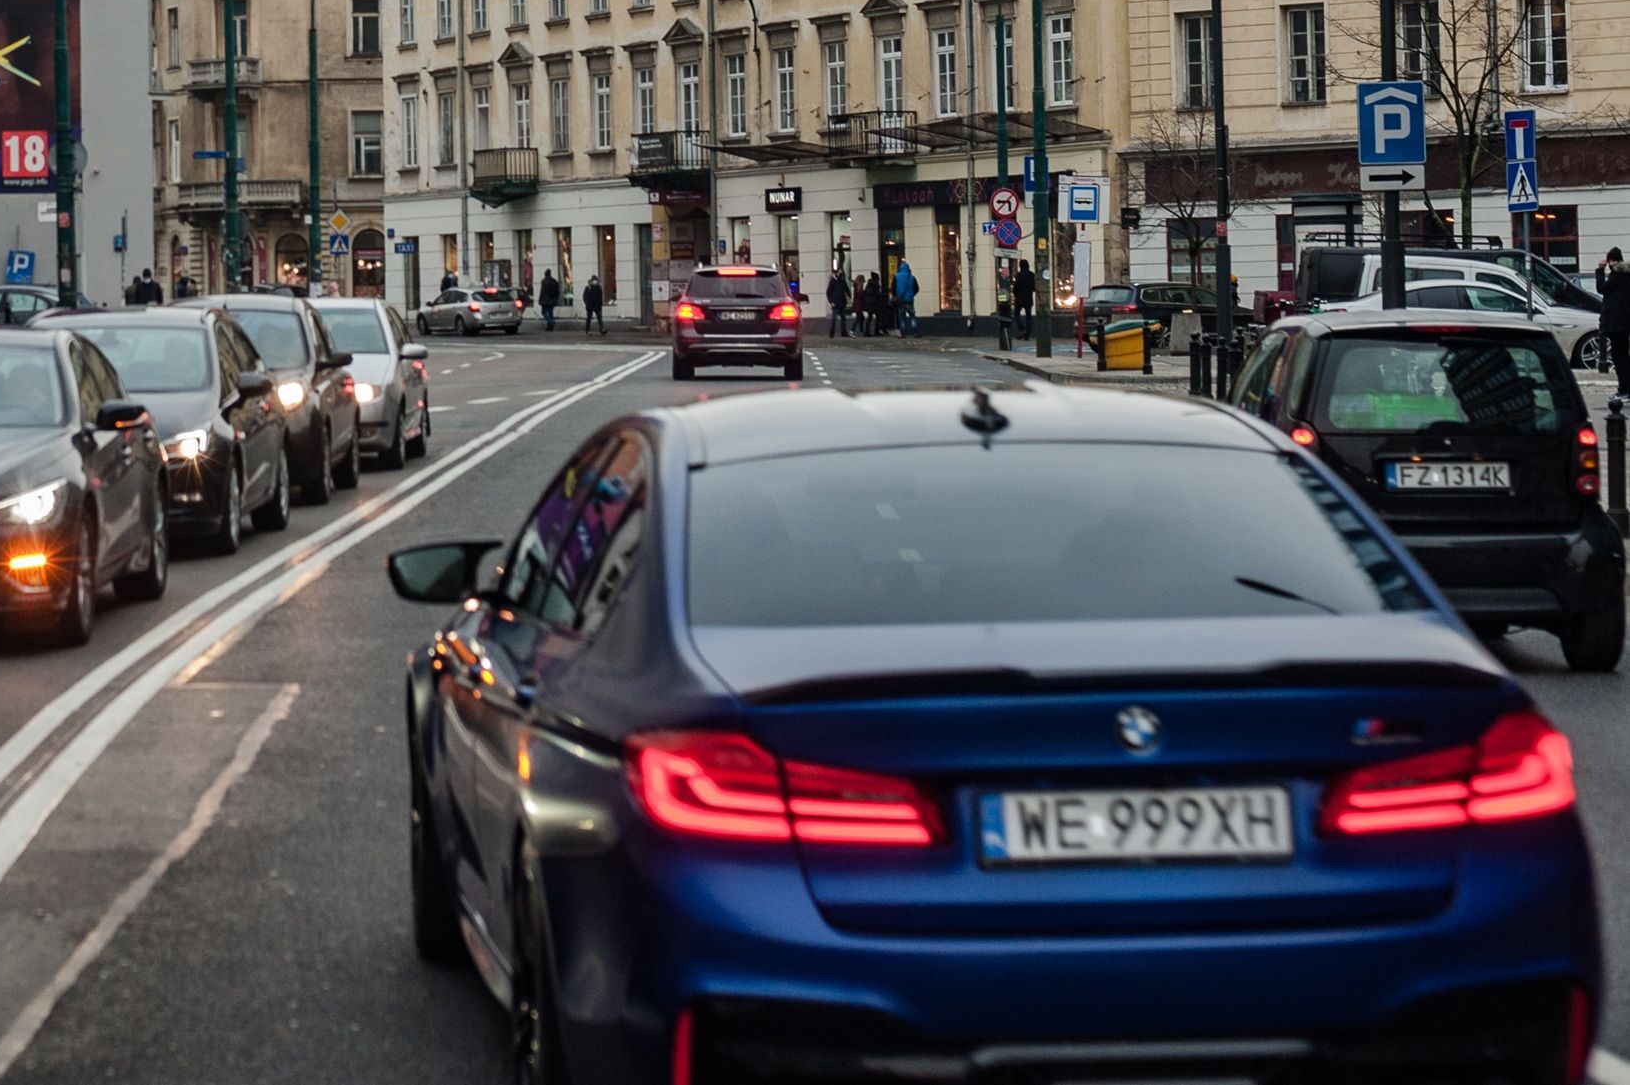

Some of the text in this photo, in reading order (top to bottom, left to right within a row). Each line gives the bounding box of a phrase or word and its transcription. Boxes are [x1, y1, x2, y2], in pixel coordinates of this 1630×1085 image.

[1374, 104, 1411, 154] P
[5, 135, 45, 173] 18
[769, 191, 795, 203] NUNAR
[397, 244, 415, 252] TAXI
[12, 253, 29, 273] P
[1399, 464, 1506, 486] FZ 1314K
[1018, 795, 1279, 850] WE 999XH
